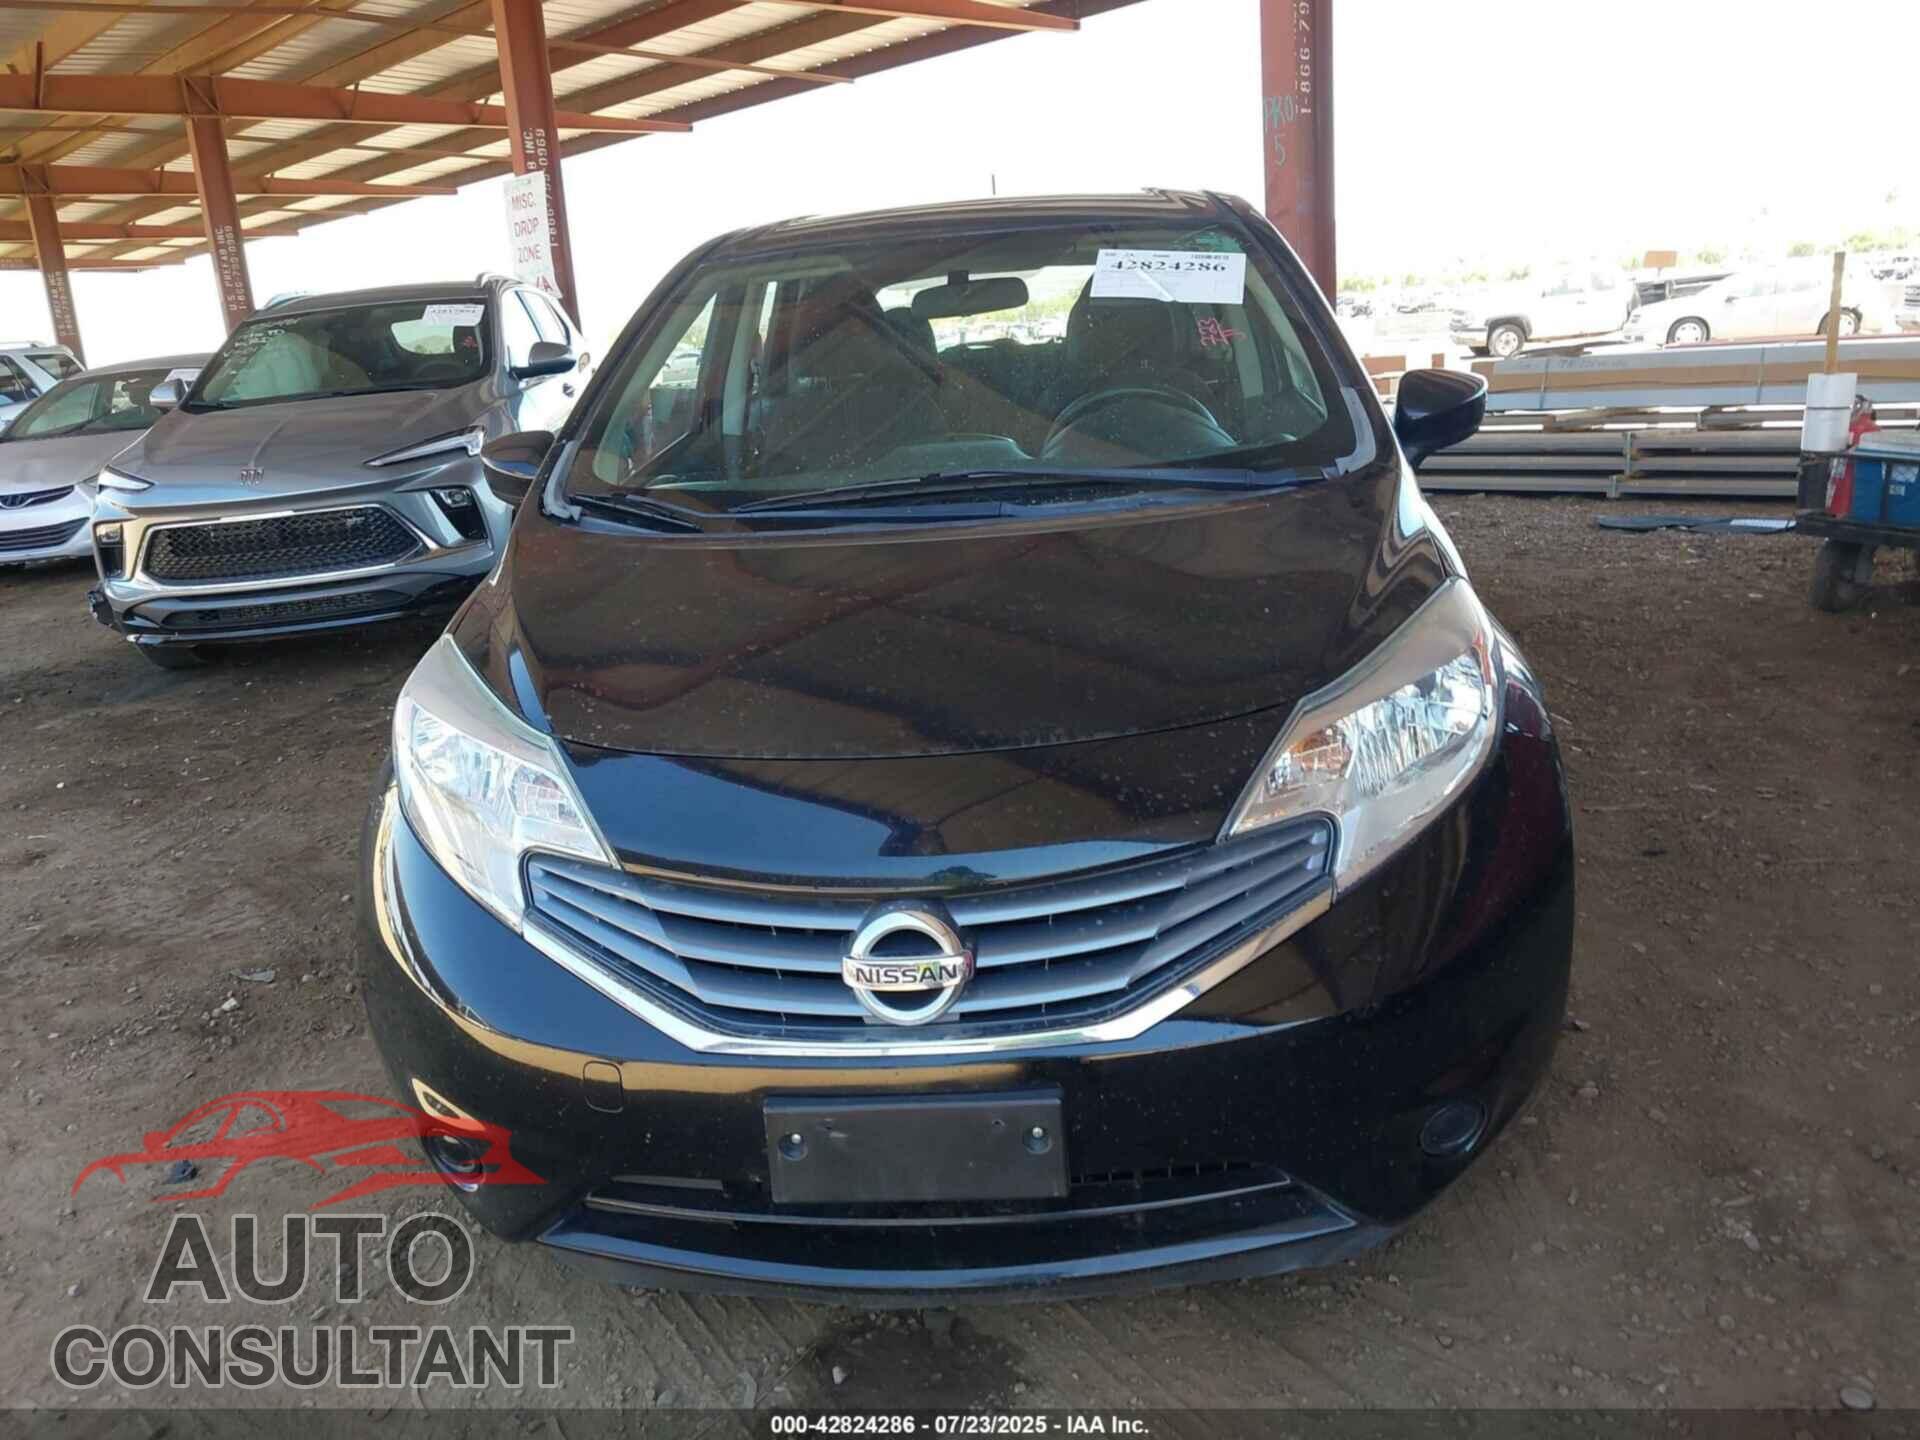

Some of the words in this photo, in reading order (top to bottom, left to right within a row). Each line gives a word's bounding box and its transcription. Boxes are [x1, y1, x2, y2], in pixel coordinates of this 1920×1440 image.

[523, 127, 535, 155] INC.
[511, 191, 537, 210] MISC.
[513, 217, 540, 238] DROP
[517, 244, 542, 264] ZONE
[1110, 260, 1227, 272] 42824286
[856, 964, 958, 984] NISSAN
